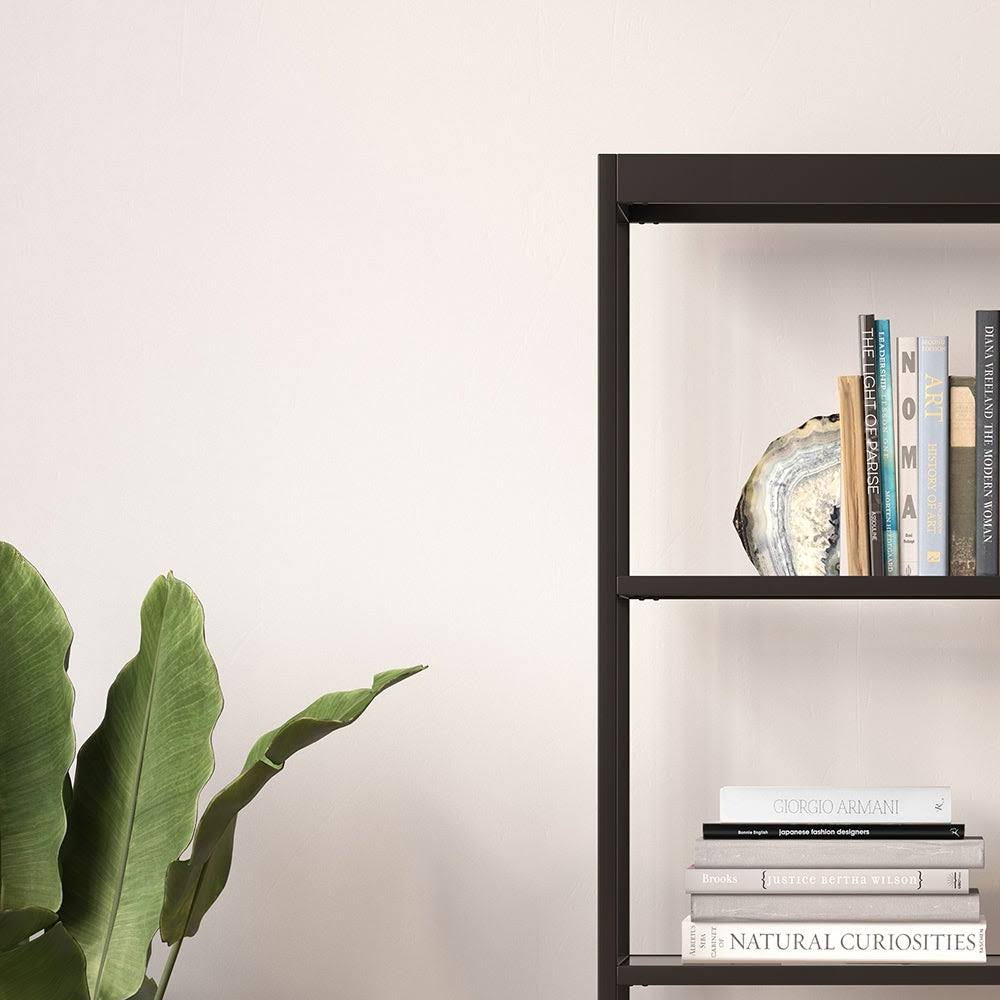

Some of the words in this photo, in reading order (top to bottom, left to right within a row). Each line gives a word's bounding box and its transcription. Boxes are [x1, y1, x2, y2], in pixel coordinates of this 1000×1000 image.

[862, 328, 874, 358] THE
[984, 326, 994, 359] DIANA
[878, 331, 887, 390] LEADERSHIP
[864, 364, 876, 411] LIGHT
[925, 371, 944, 424] ART
[984, 362, 994, 419] VREELAND
[865, 414, 877, 438] OF
[881, 395, 889, 433] LESSON
[983, 423, 993, 446] THE
[927, 443, 937, 491] HISTORY
[983, 449, 993, 497] MODERN
[927, 494, 937, 509] OF
[927, 512, 937, 535] ART
[983, 501, 993, 543] WOMAN
[773, 799, 833, 814] GIORGIO
[837, 799, 899, 814] ARMANI
[810, 828, 835, 836] fashion
[836, 828, 870, 837] designers
[702, 873, 738, 883] Brooks
[730, 933, 835, 950] NATURAL
[840, 932, 976, 951] CURIOSITIES
